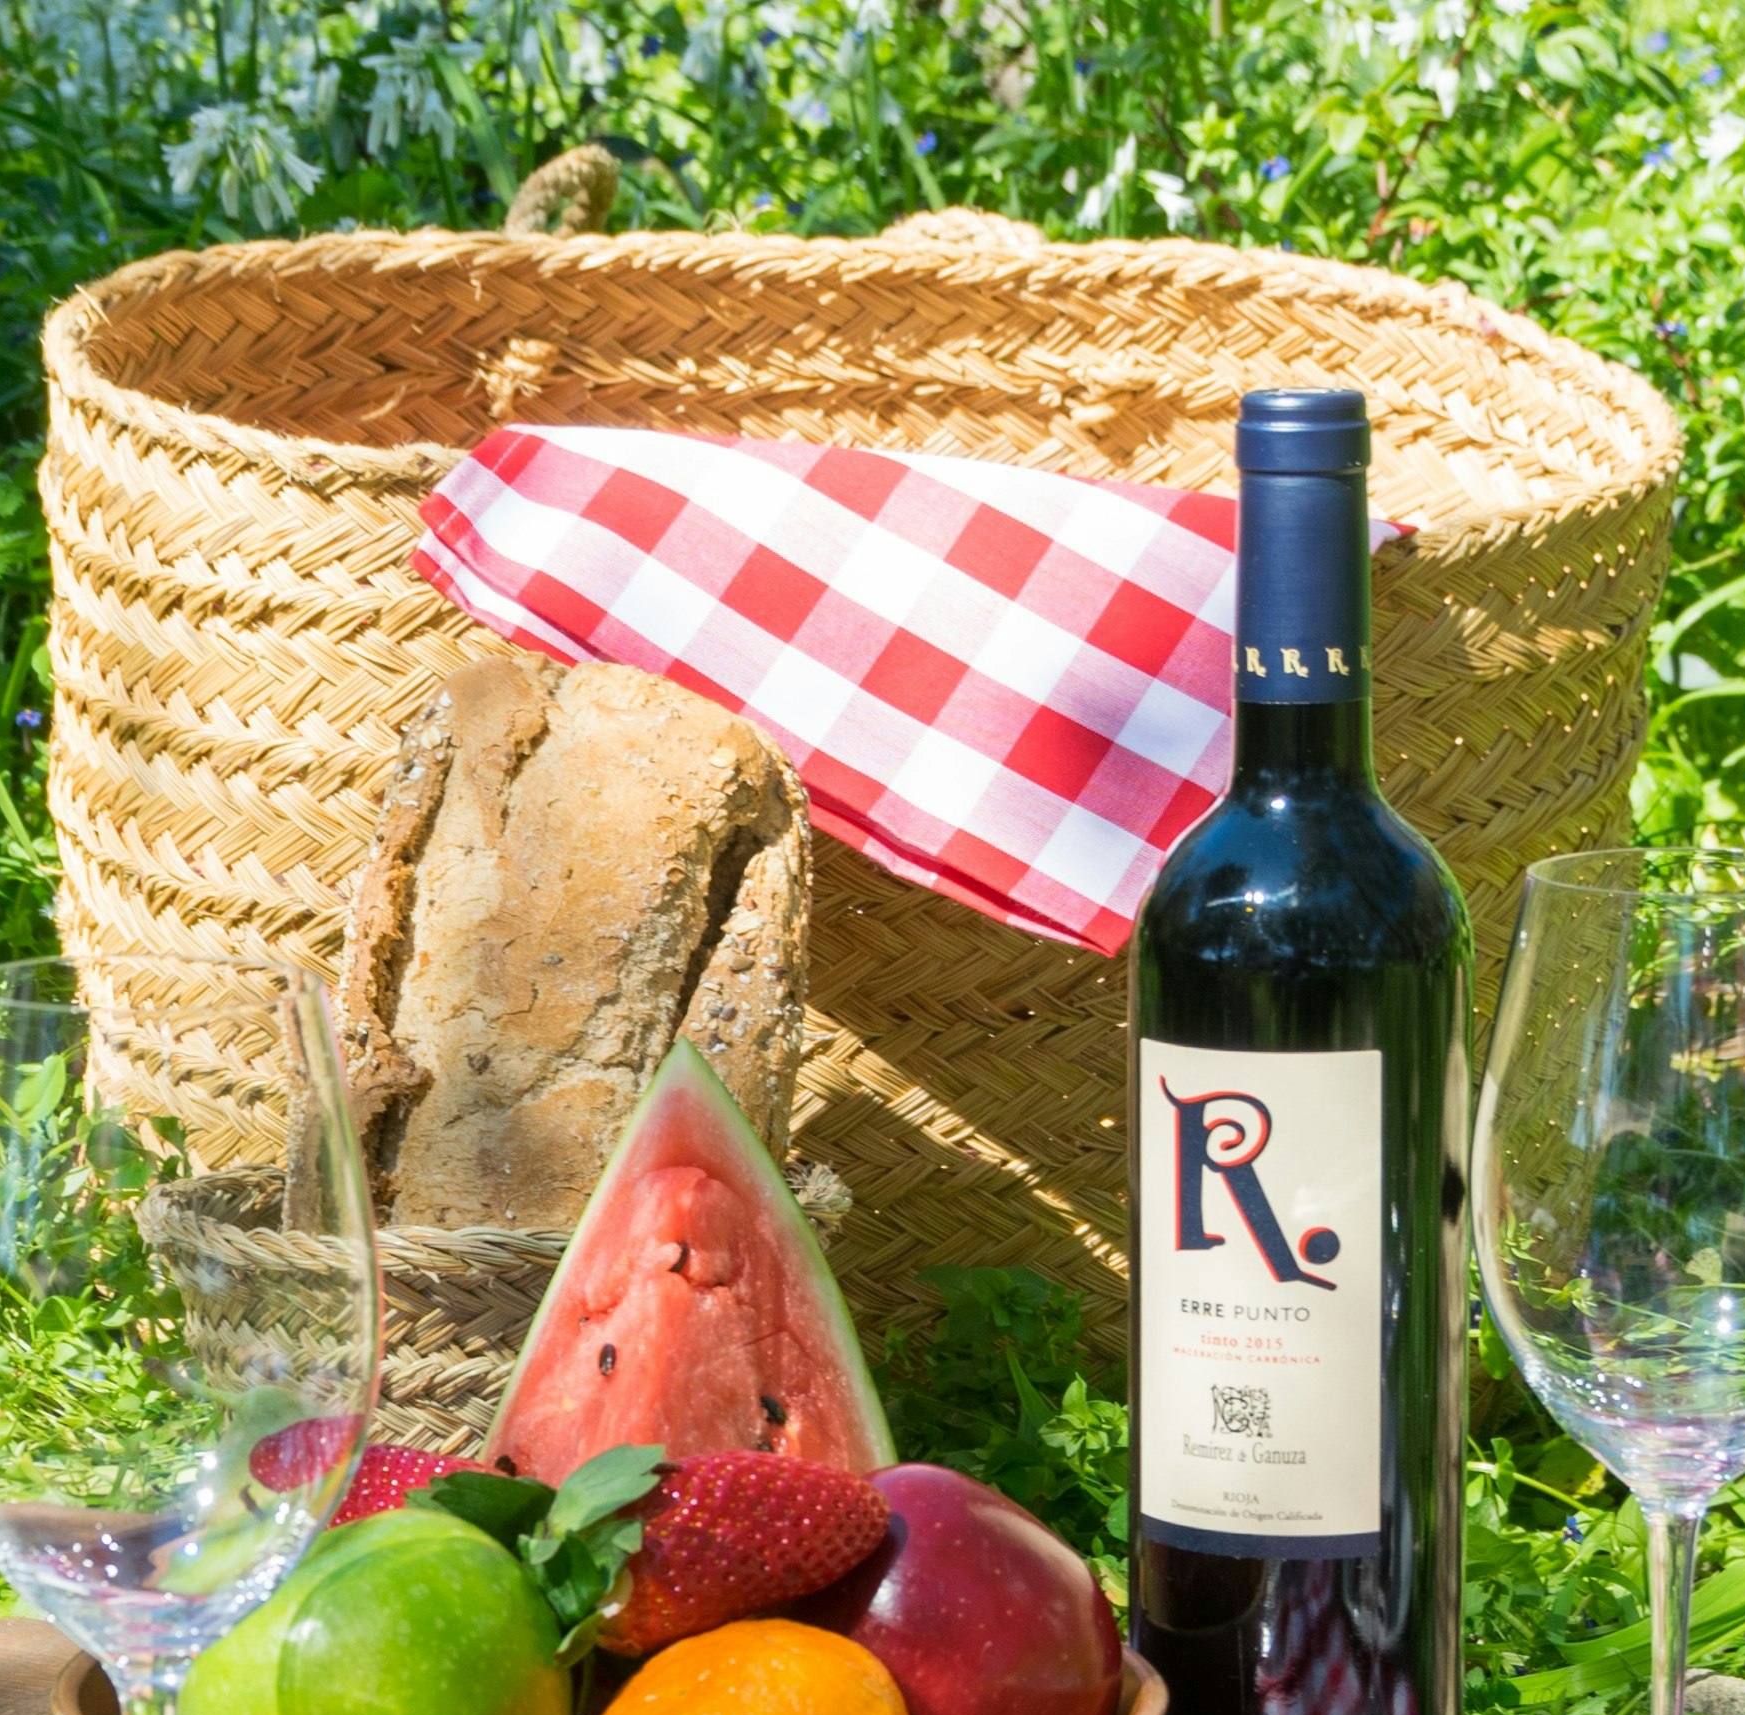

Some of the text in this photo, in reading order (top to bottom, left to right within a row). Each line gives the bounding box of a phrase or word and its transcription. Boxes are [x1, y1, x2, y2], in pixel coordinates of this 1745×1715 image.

[1181, 1299, 1310, 1322] ERRE PUNTO
[1201, 1331, 1283, 1350] tinto 2015
[1173, 1346, 1321, 1364] MACERACIÓN CARBÓNICA
[1252, 1443, 1307, 1465] Ganuza
[1222, 1491, 1259, 1505] RIOJA
[1172, 1500, 1323, 1522] Denominación de Origen Calificada
